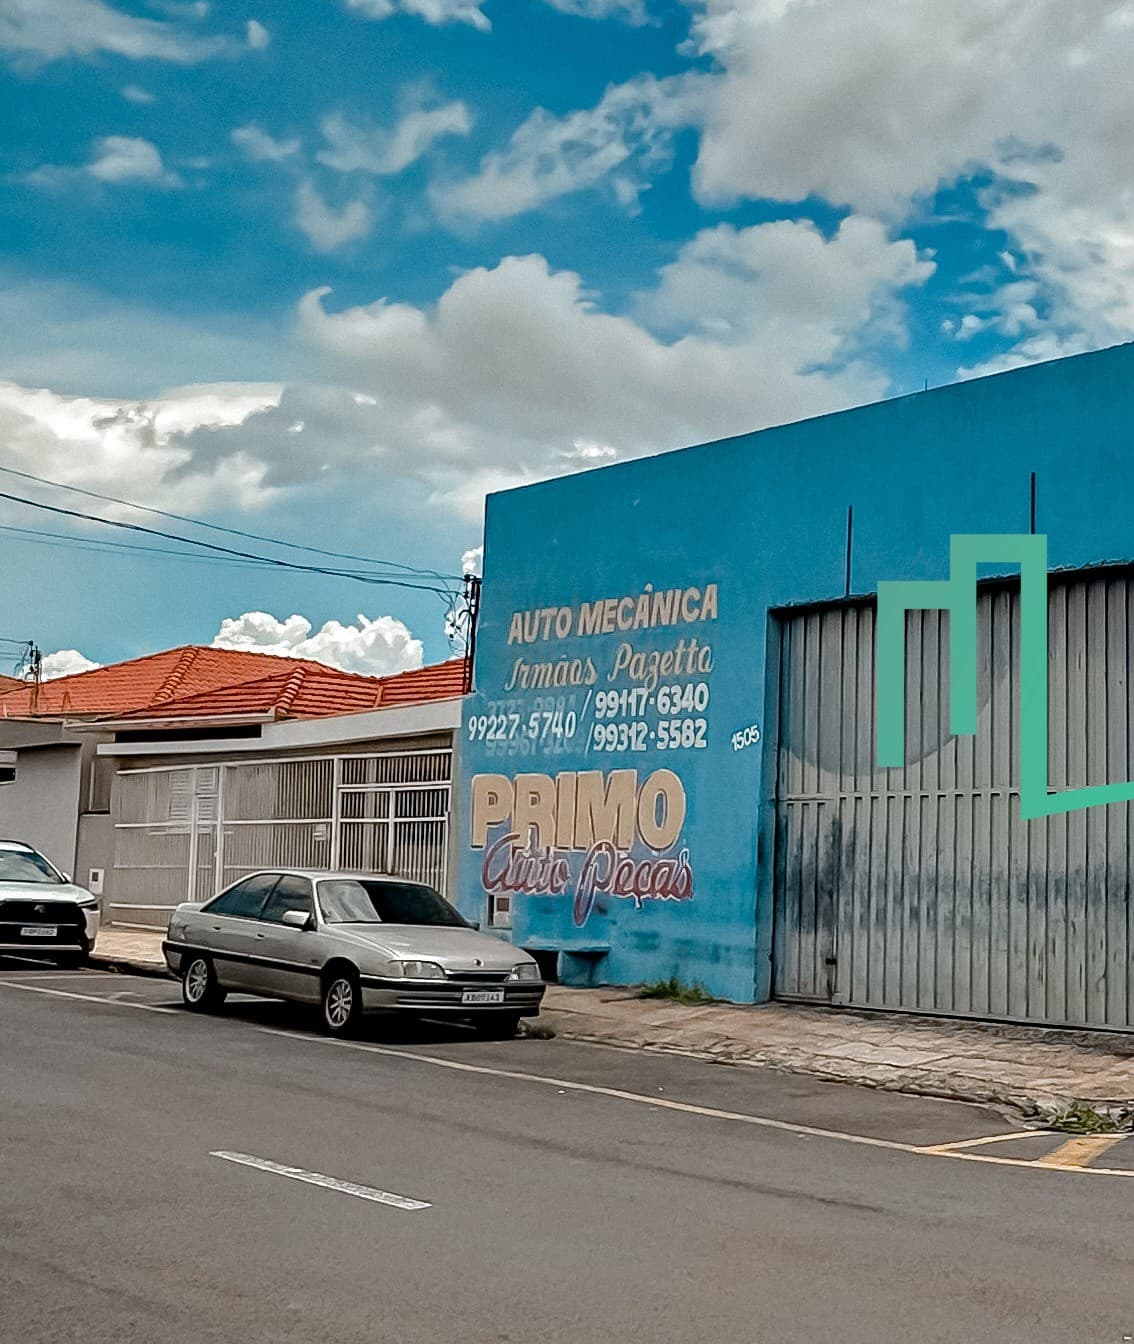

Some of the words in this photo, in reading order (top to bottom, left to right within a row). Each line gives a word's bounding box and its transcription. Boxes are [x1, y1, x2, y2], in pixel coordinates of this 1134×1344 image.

[507, 606, 572, 646] AUTO
[576, 583, 718, 637] MECÂNICA
[504, 654, 598, 692] Irmãos
[731, 724, 760, 752] 1505
[470, 769, 686, 852] PRIMO
[482, 833, 573, 896] Auto
[573, 840, 694, 930] Peças
